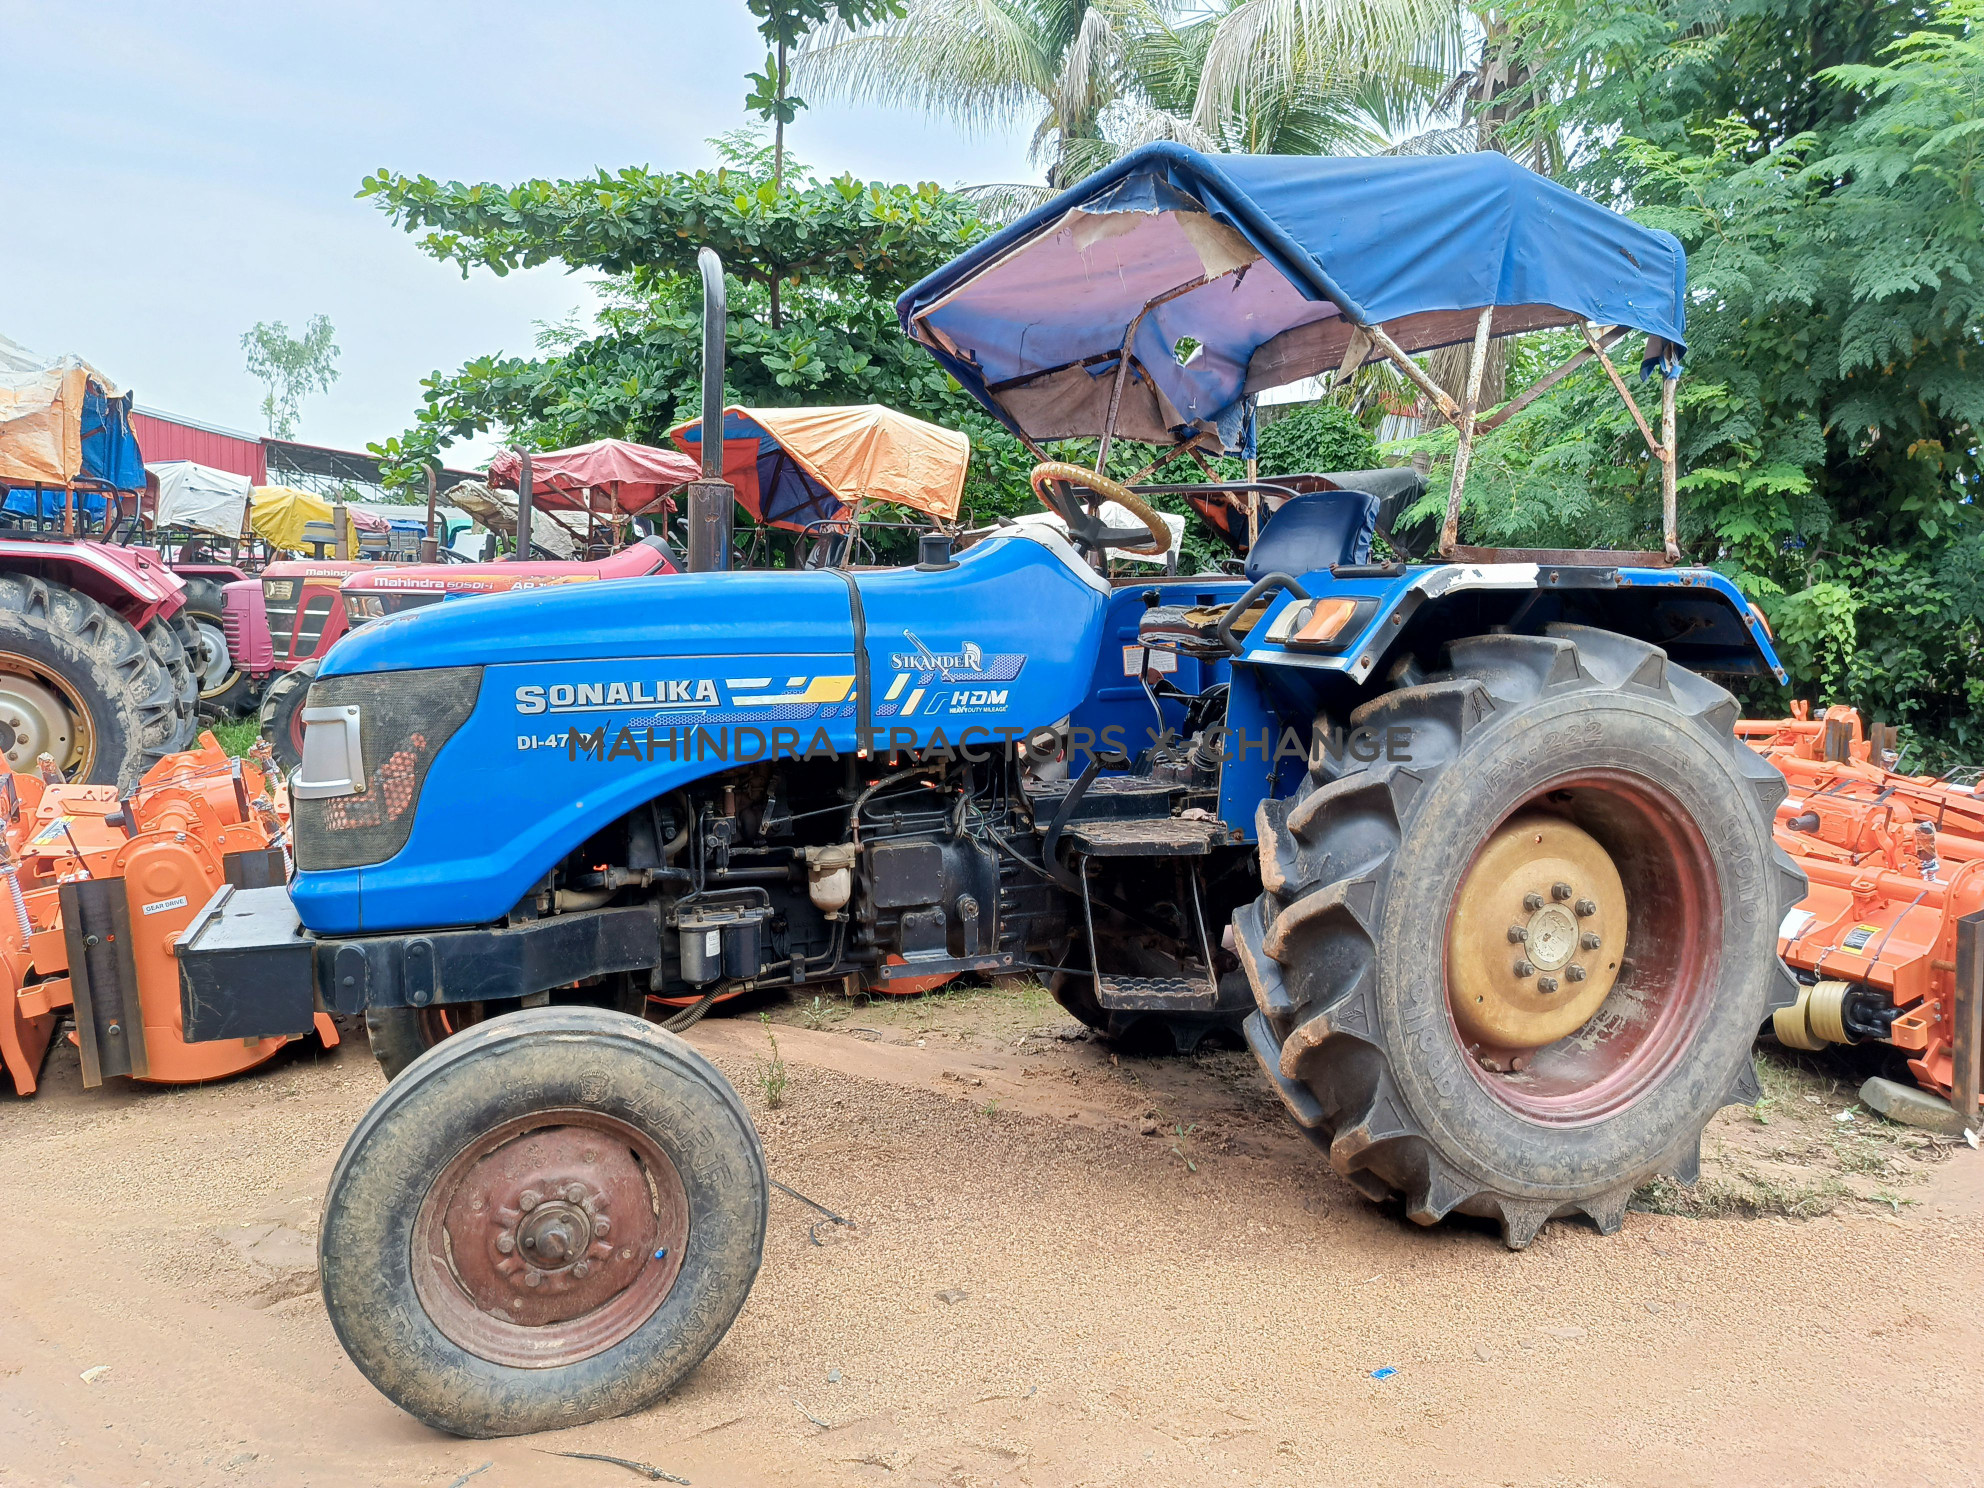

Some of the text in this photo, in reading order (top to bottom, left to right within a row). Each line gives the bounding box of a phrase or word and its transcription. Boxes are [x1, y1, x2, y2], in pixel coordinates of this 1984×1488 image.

[306, 569, 355, 577] Mahindr
[374, 577, 445, 588] Mahindra
[891, 653, 983, 672] SIKANDER
[516, 680, 719, 714] SONALIKA
[951, 690, 1008, 705] HDM
[1719, 814, 1760, 923] apollo
[145, 898, 185, 912] GEAR DRIVE
[1402, 979, 1455, 1097] apollo
